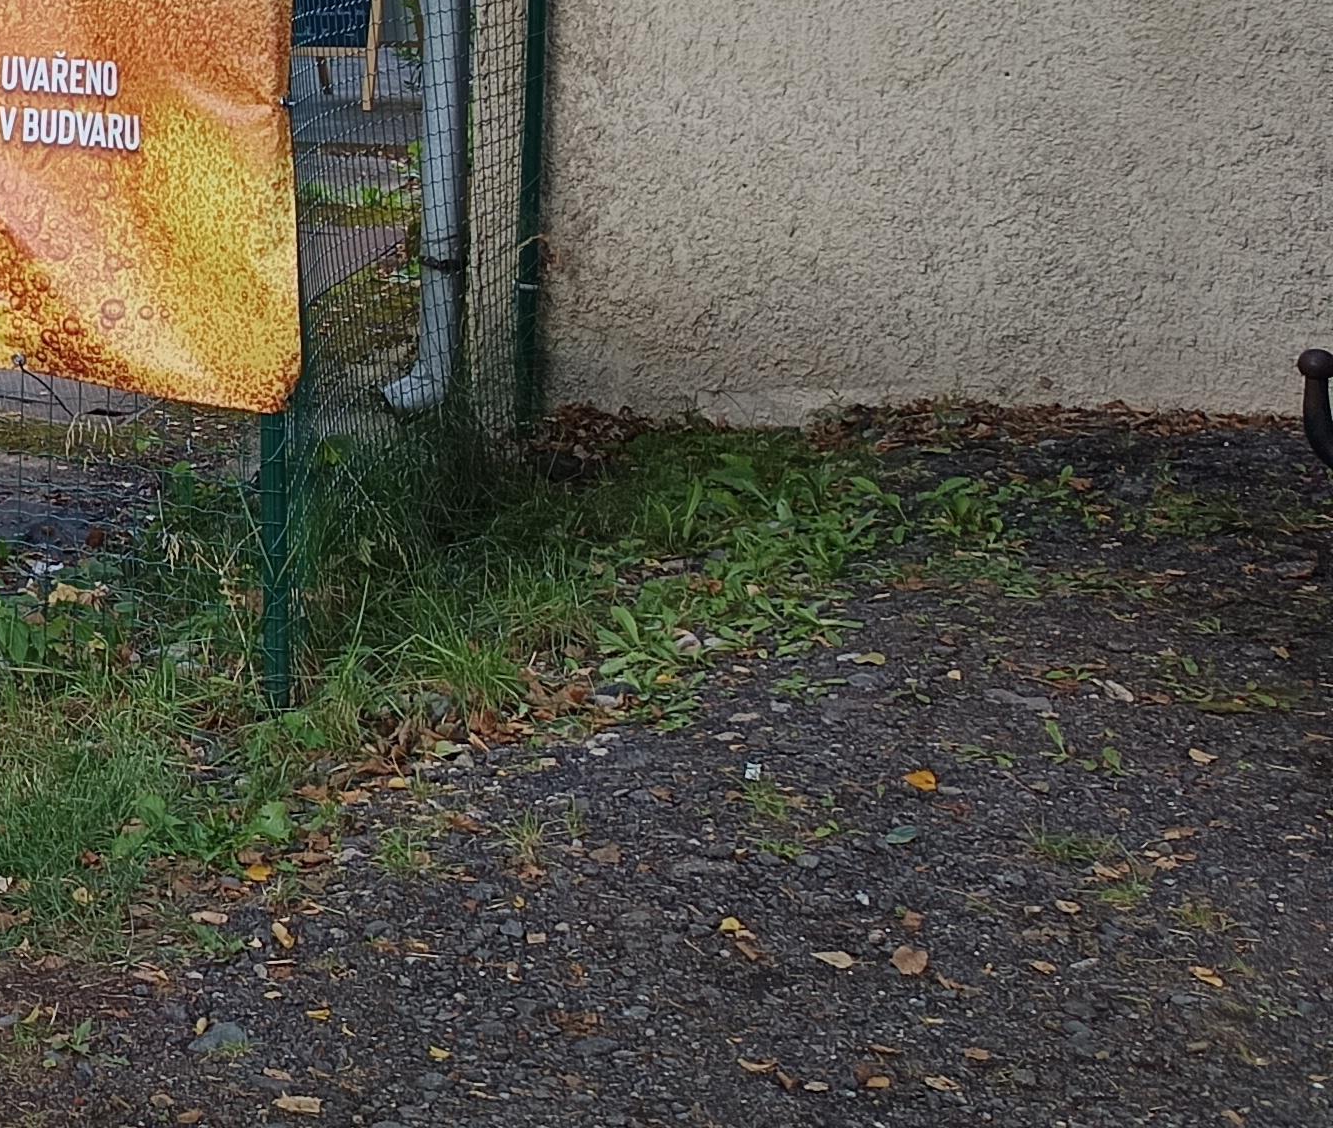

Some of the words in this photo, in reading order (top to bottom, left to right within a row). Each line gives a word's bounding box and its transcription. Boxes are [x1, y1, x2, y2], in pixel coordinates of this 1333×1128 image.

[1, 50, 118, 97] UVAŘENO
[0, 106, 17, 142] V
[22, 107, 141, 151] BUDVARU
